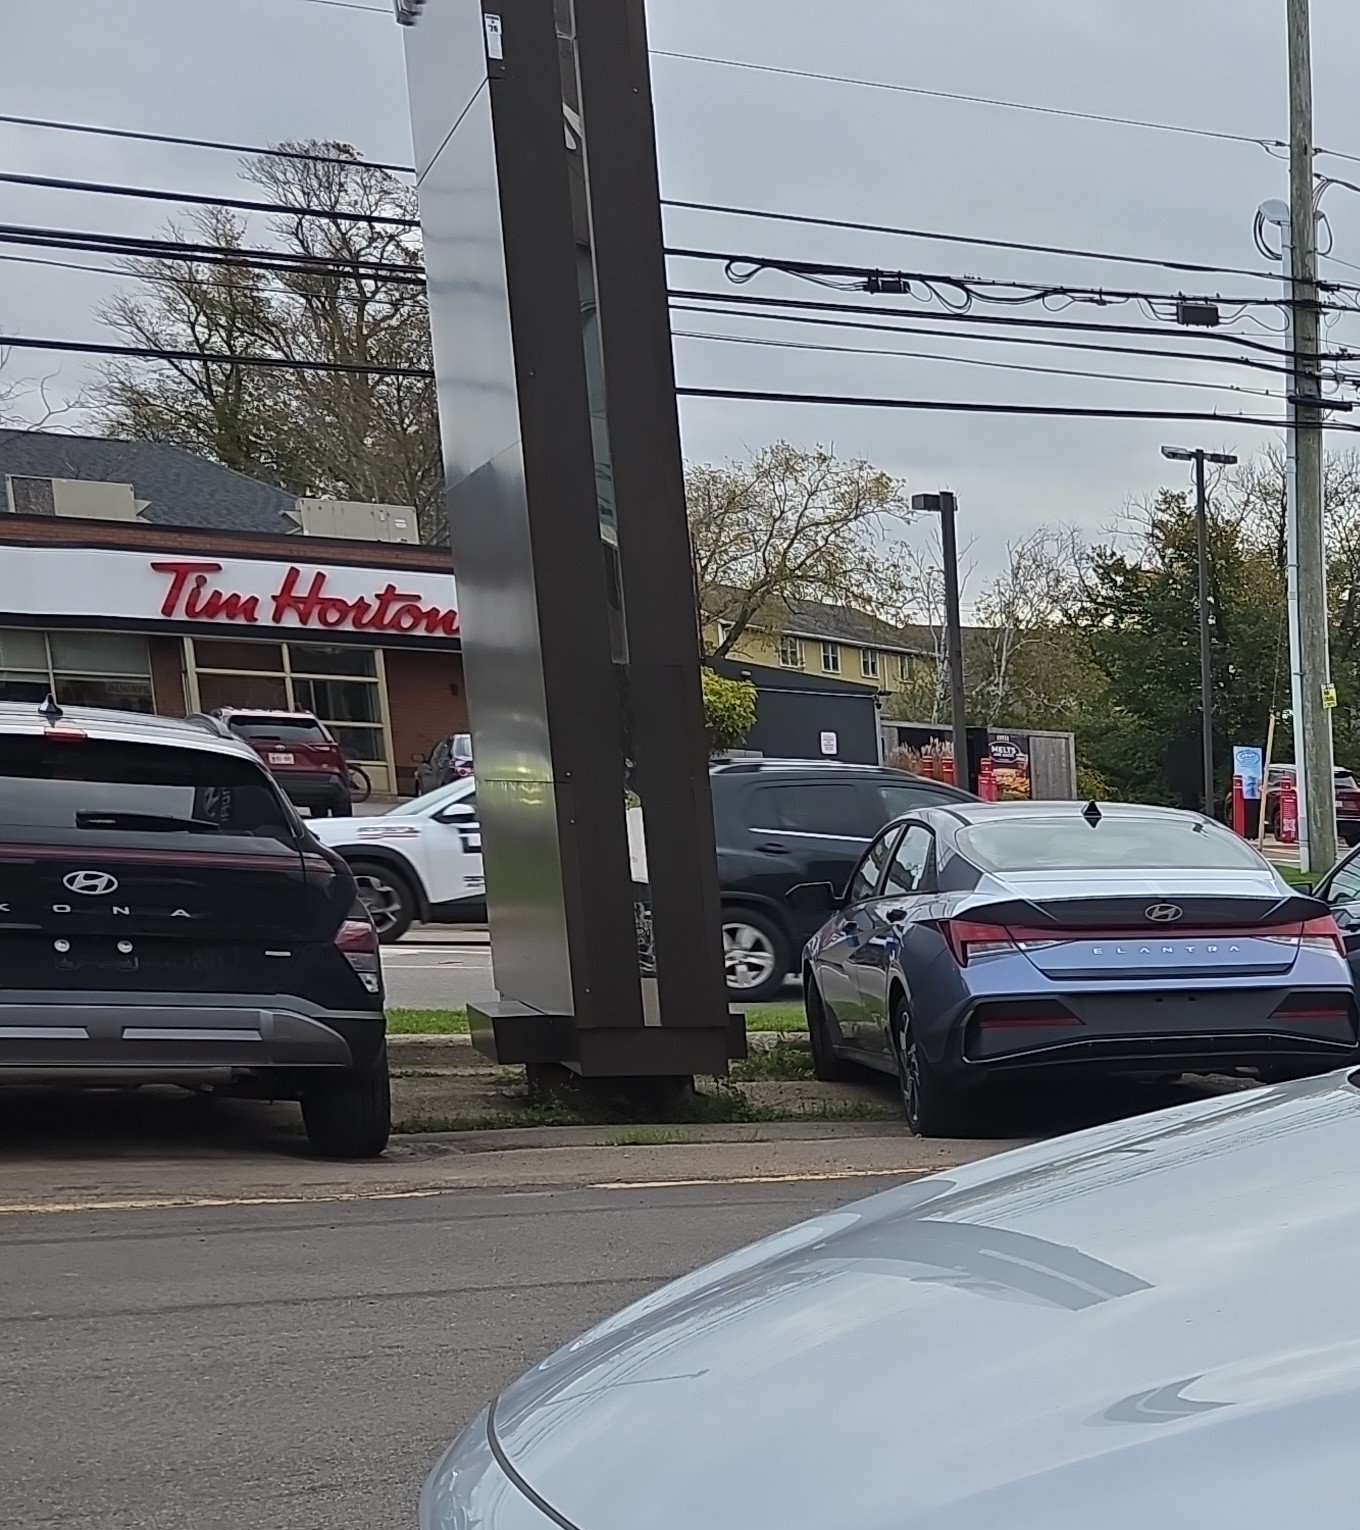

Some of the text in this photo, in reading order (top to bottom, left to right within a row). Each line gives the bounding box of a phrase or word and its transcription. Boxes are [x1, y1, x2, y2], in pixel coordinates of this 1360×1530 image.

[150, 562, 462, 637] Tim Horton
[1092, 944, 1240, 955] ELANTRA
